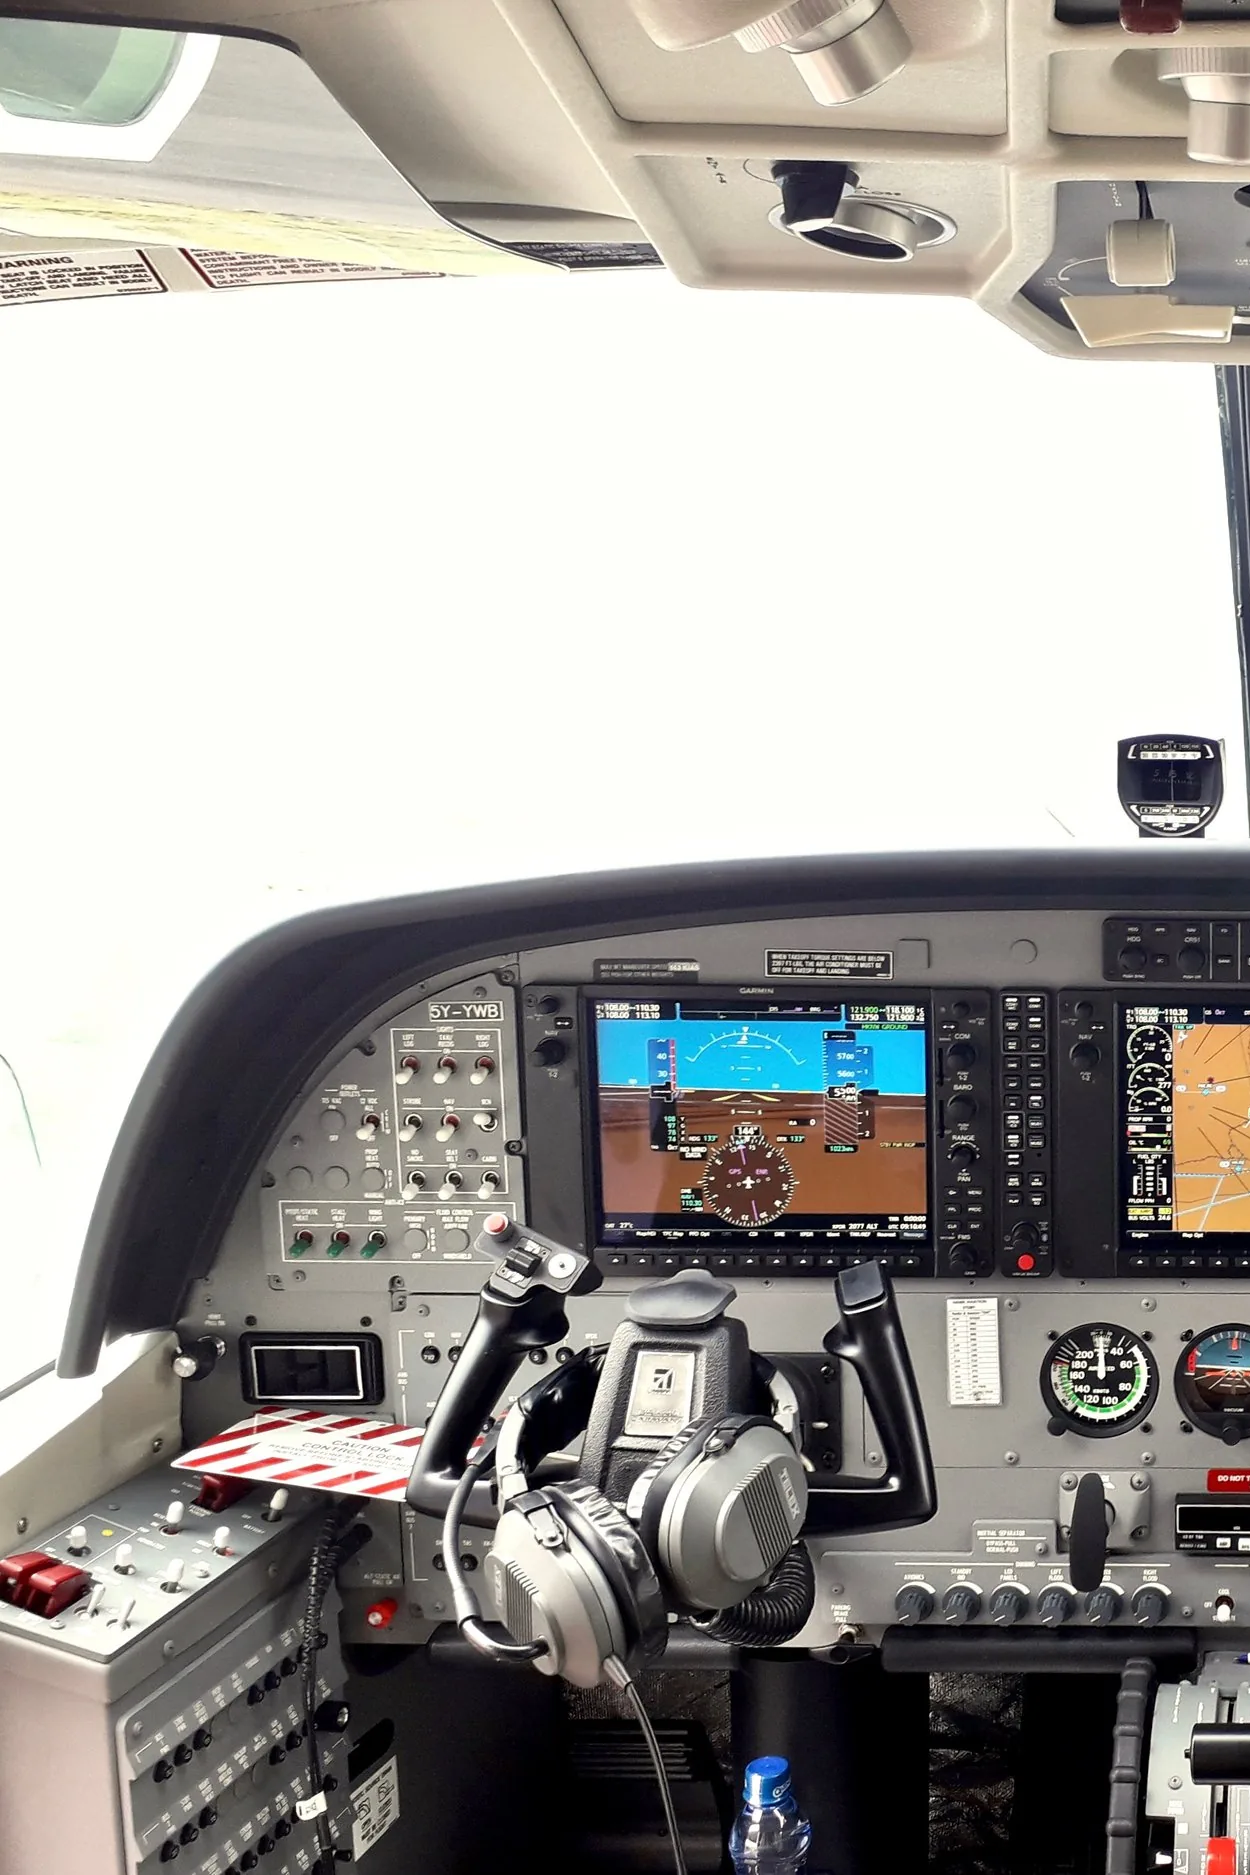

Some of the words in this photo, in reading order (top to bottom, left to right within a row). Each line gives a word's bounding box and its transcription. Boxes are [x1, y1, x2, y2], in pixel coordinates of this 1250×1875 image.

[43, 266, 82, 274] LOCKED
[430, 1004, 499, 1018] 5Y-YWB
[604, 1004, 629, 1012] 108.00
[635, 1004, 660, 1012] 110.30
[850, 1006, 878, 1014] 121.900
[885, 1006, 915, 1014] 118.100
[1165, 1008, 1188, 1016] 110.30
[737, 1127, 758, 1135] 144°
[1075, 1351, 1094, 1359] 200
[1110, 1347, 1124, 1355] 40
[1071, 1361, 1087, 1369] 180
[1120, 1361, 1132, 1369] 60
[1069, 1371, 1085, 1380] 160
[1074, 1385, 1091, 1393] 140
[1118, 1383, 1132, 1392] 80
[1083, 1395, 1099, 1404] 120
[1102, 1396, 1118, 1404] 100
[331, 1440, 391, 1453] CAUTION
[301, 1442, 362, 1456] CONTROL
[366, 1452, 405, 1462] LOCK
[778, 1467, 801, 1521] TELEX
